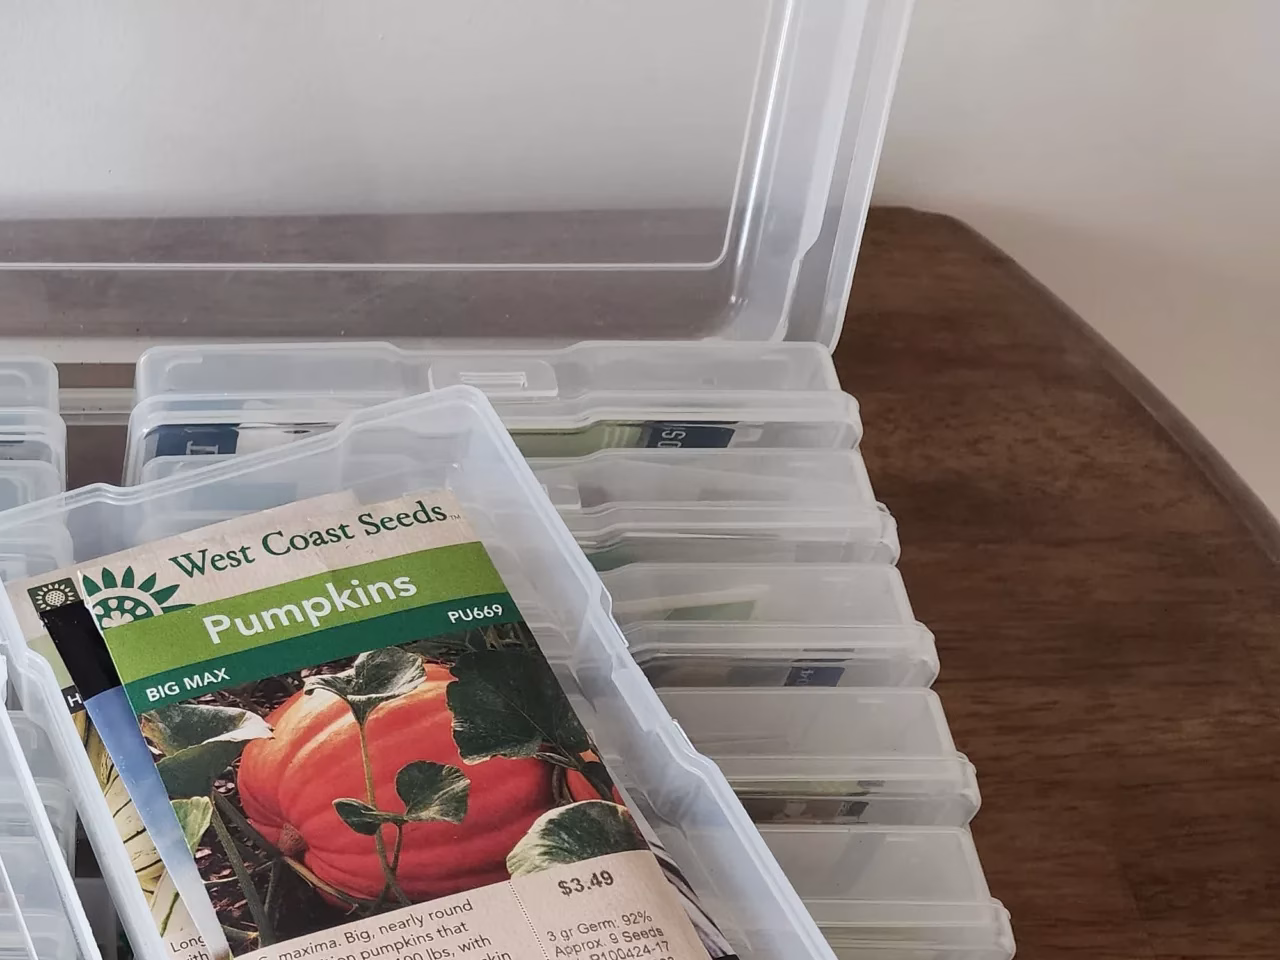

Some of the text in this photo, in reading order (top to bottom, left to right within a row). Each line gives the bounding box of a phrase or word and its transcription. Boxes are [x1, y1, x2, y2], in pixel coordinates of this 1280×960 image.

[168, 543, 256, 579] West
[261, 521, 356, 559] Coast
[357, 499, 448, 538] Seeds
[202, 573, 418, 645] Pumpkins
[447, 604, 504, 625] PU669
[145, 667, 231, 702] BIG MAX
[557, 869, 615, 897] $3.49
[344, 928, 375, 945] Big,
[378, 913, 425, 936] nearly
[428, 899, 474, 922] round
[436, 920, 469, 937] that
[546, 910, 653, 944] 3 gr Germ: 92%
[457, 934, 492, 953] with
[554, 925, 665, 958] Approx. 9 Seeds
